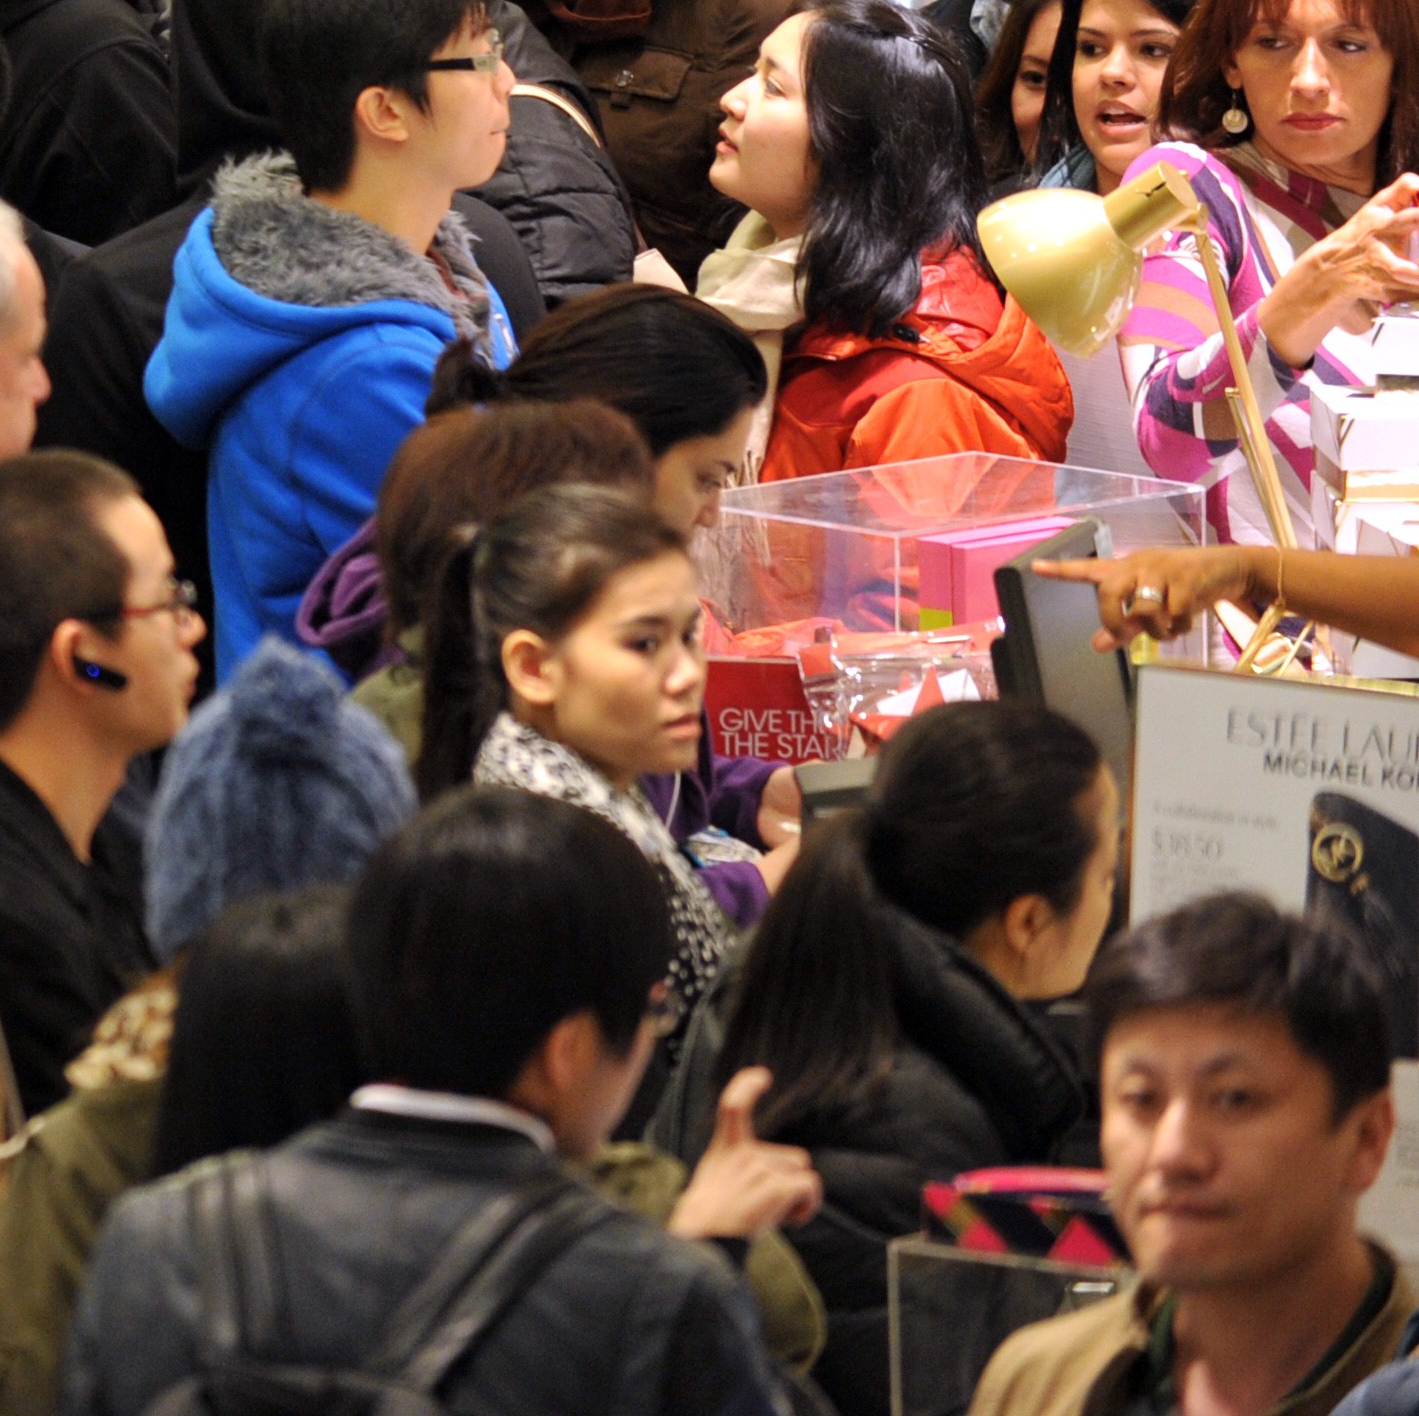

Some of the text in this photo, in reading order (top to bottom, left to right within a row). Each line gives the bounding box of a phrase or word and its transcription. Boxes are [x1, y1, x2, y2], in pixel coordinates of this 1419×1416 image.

[718, 707, 783, 734] GIVE
[719, 731, 769, 758] THE
[1341, 718, 1419, 770] LAU
[1263, 749, 1419, 792] MICHAEL KO
